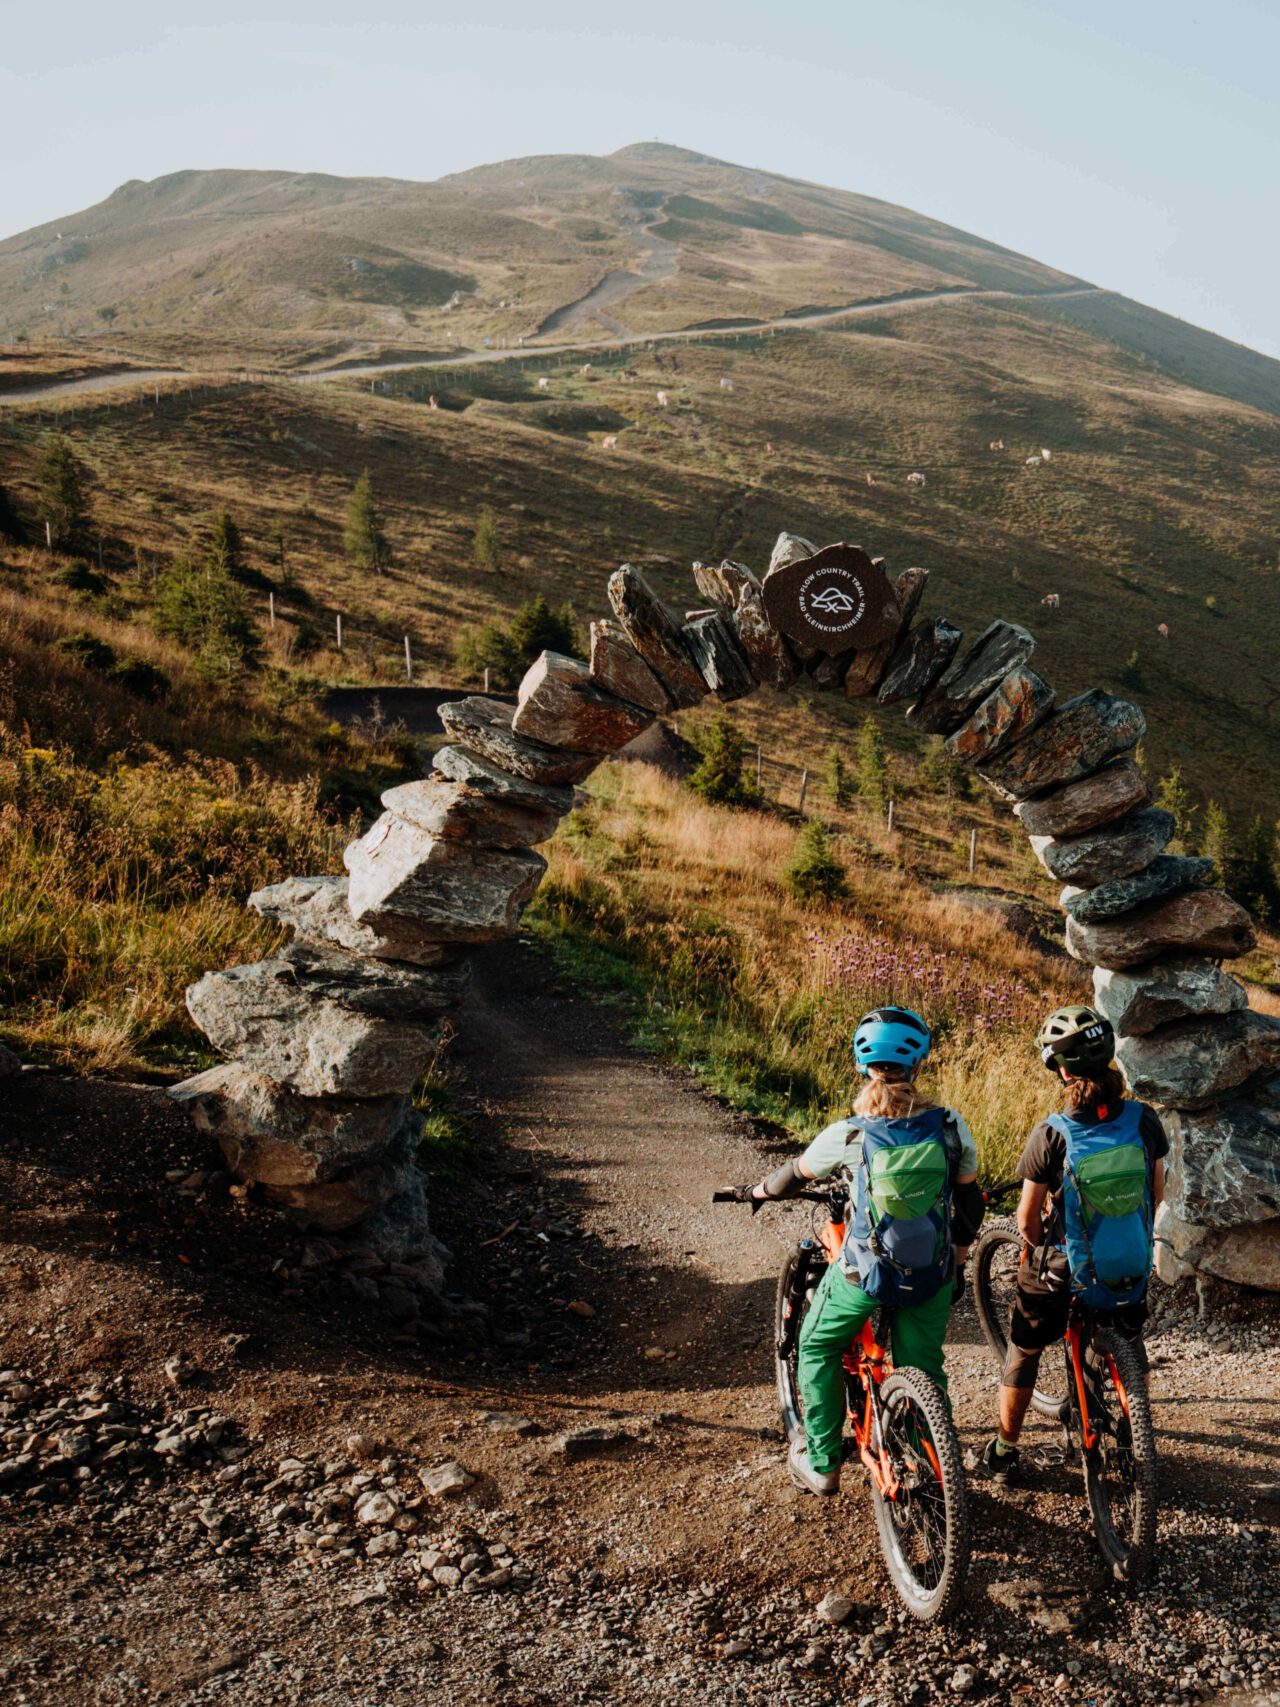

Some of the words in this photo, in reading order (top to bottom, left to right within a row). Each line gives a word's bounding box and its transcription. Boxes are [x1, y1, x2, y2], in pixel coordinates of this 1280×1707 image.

[800, 573, 816, 592] FLOW
[815, 567, 852, 579] COUNTRY
[852, 577, 865, 598] TRAIL
[799, 596, 807, 612] BAD
[804, 602, 866, 632] KLEINKIRCHHEIMER
